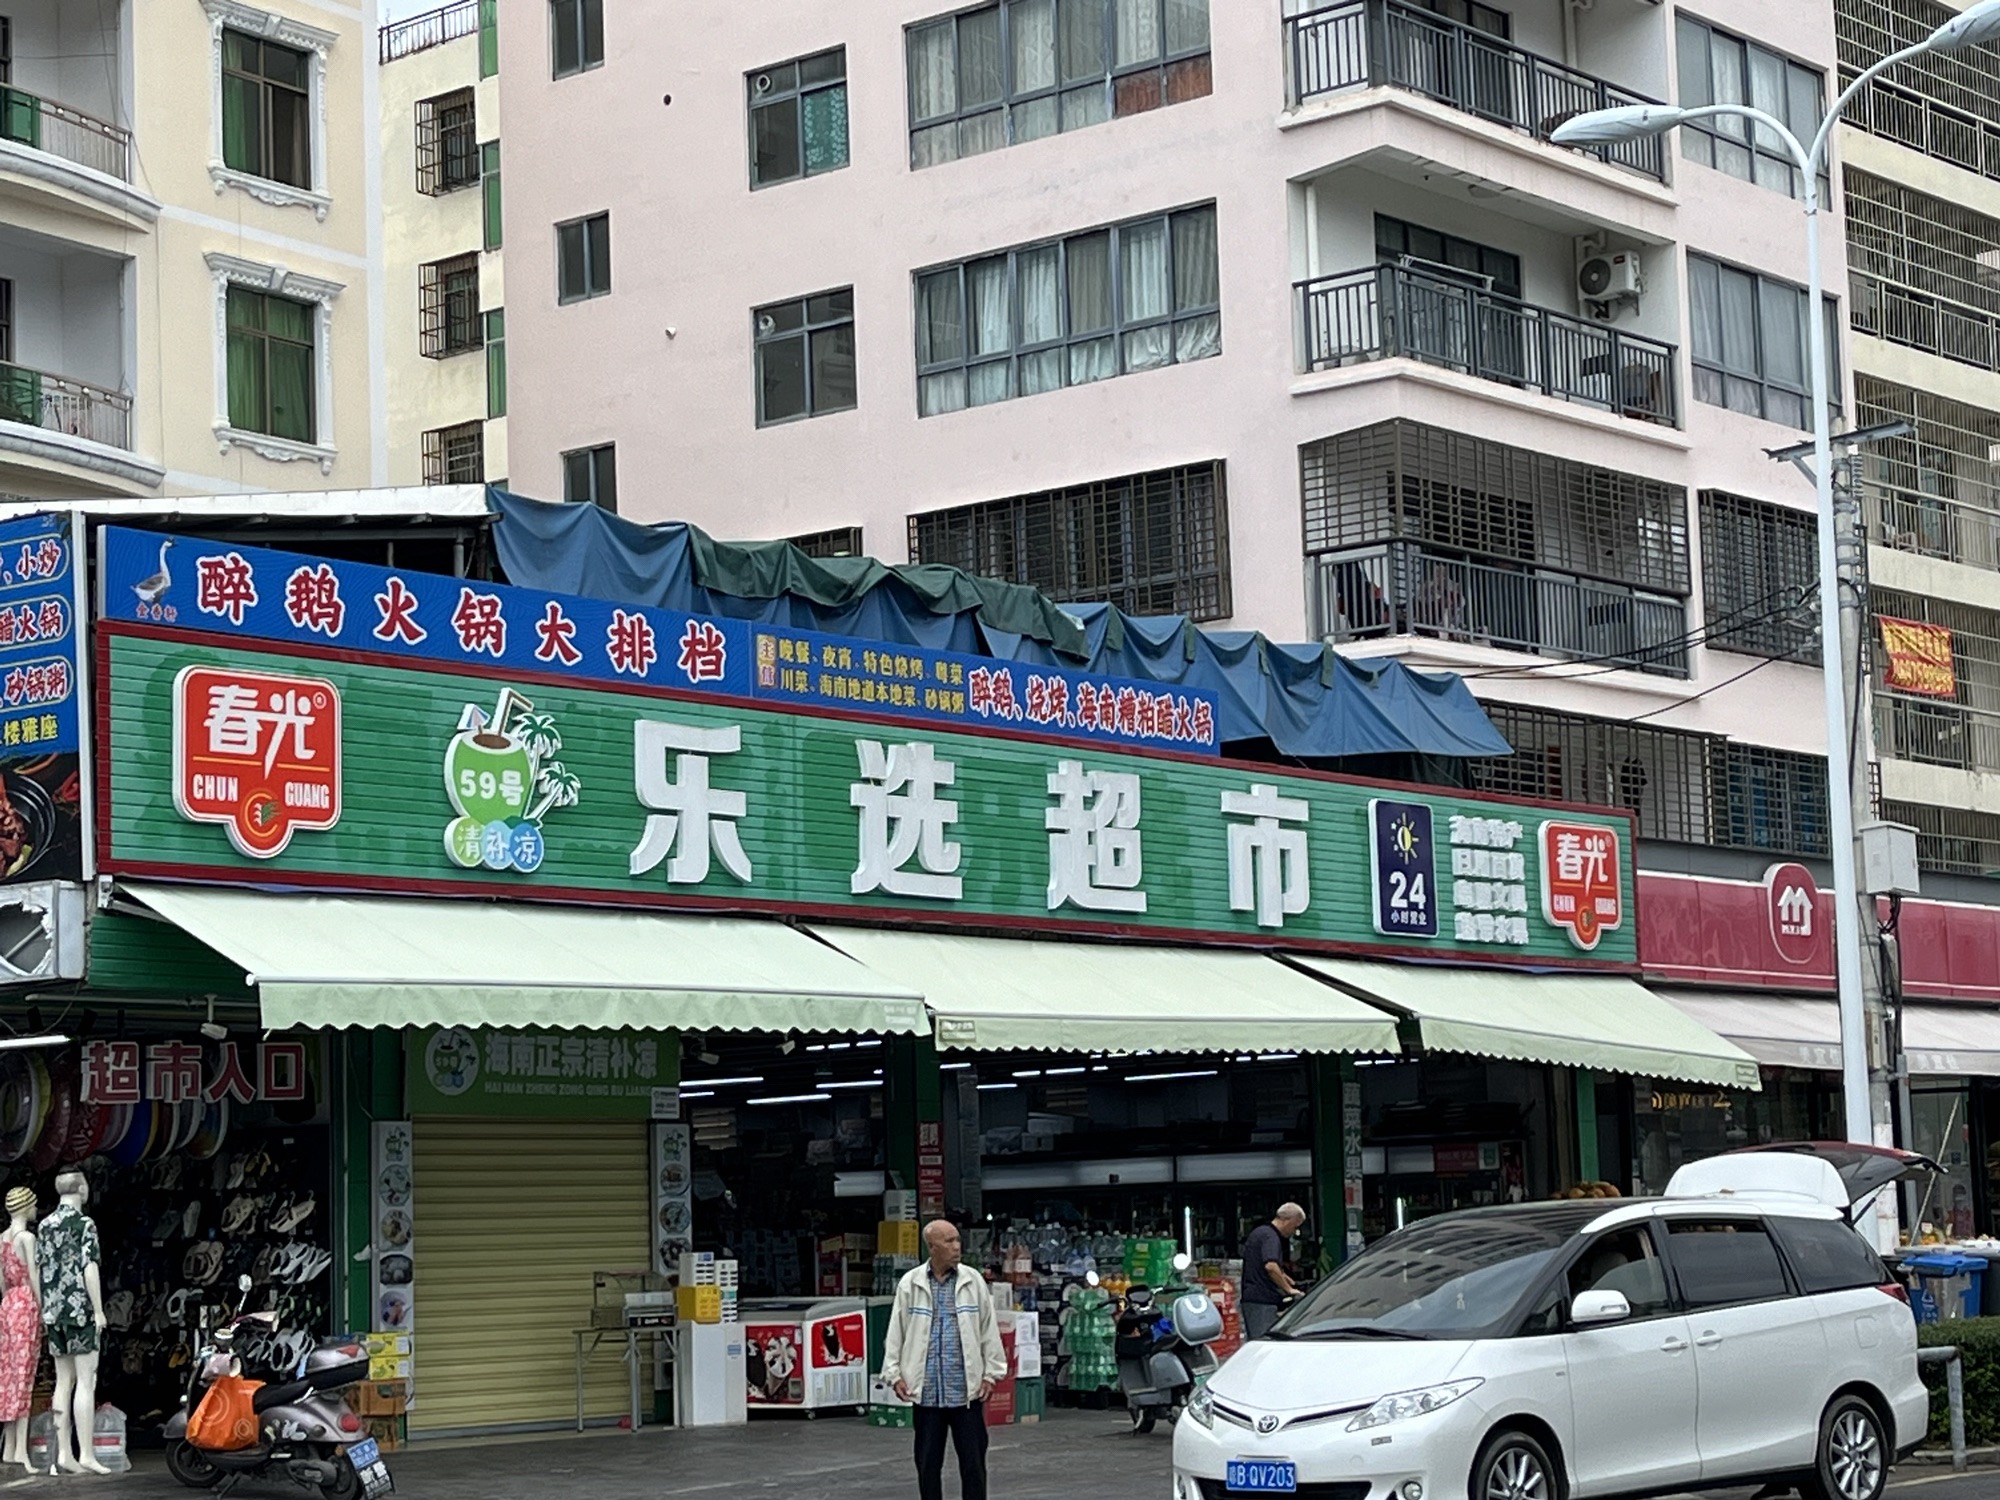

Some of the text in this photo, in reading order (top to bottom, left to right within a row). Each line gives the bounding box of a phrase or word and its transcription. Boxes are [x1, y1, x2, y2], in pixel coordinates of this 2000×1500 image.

[0, 539, 62, 585] 、小炒
[195, 551, 729, 686] 醉鹅火锅大排档
[0, 714, 58, 747] 楼雅座
[203, 684, 317, 780] 春光
[192, 773, 330, 810] CHUN GUANG
[459, 768, 525, 807] 59号
[456, 825, 539, 866] 清补凉
[629, 719, 1310, 928] 乐选超市
[1555, 832, 1608, 897] 春光
[1388, 870, 1427, 911] 24
[484, 1031, 658, 1080] 海南正宗清补凉
